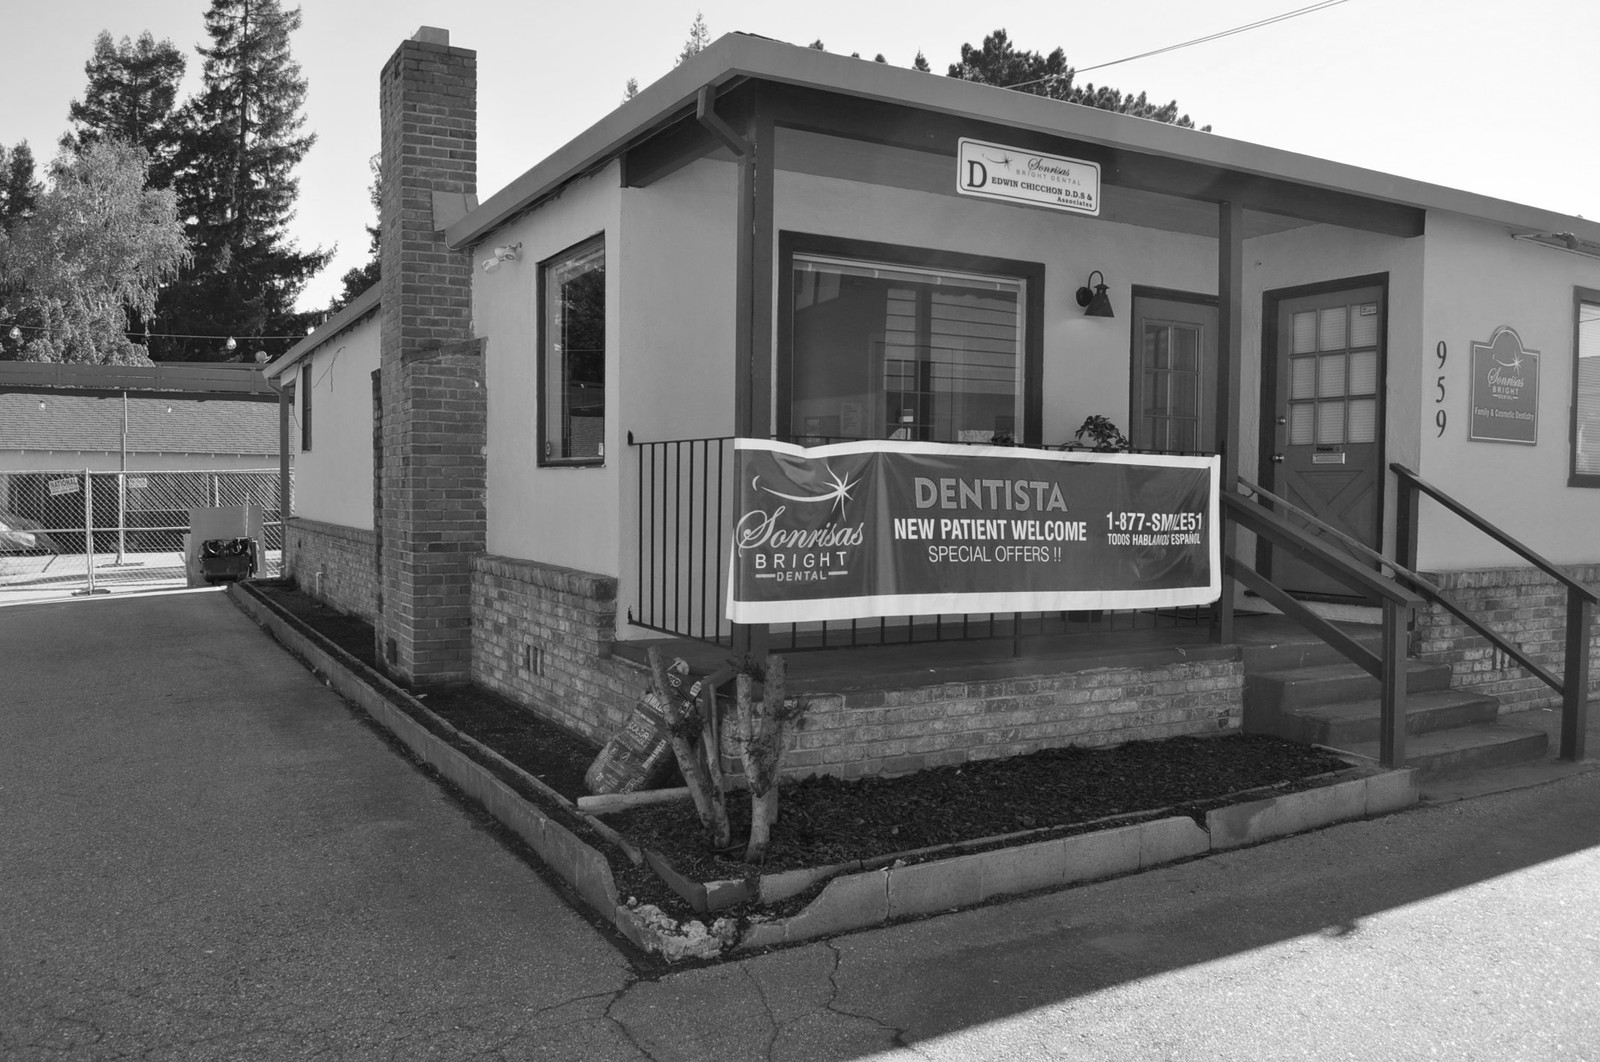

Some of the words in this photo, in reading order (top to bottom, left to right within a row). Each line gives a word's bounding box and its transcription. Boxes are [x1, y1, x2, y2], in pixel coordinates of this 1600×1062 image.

[1027, 158, 1070, 177] Sonrisas
[991, 176, 1019, 188] EDWIN
[1020, 181, 1063, 195] CHICCHON
[1016, 169, 1047, 180] BRIGHT
[1050, 175, 1081, 186] DENTAL
[1056, 196, 1093, 208] Associates
[1488, 366, 1525, 388] Sonrisas
[1492, 385, 1519, 396] BRIGHT
[914, 477, 1069, 512] DENTISTA
[736, 505, 865, 558] Sonrisas
[894, 518, 936, 540] NEW
[940, 519, 1007, 541] PATIENT
[1011, 519, 1087, 542] WELCOME
[1107, 533, 1131, 545] TODOS
[1132, 533, 1170, 546] HABLAMOS
[1170, 531, 1201, 545] ESPAÑOL
[755, 551, 847, 569] BRIGHT
[928, 545, 991, 563] SPECIAL
[995, 545, 1050, 563] OFFERS
[1054, 546, 1062, 563] !!
[776, 570, 828, 582] DENTAL
